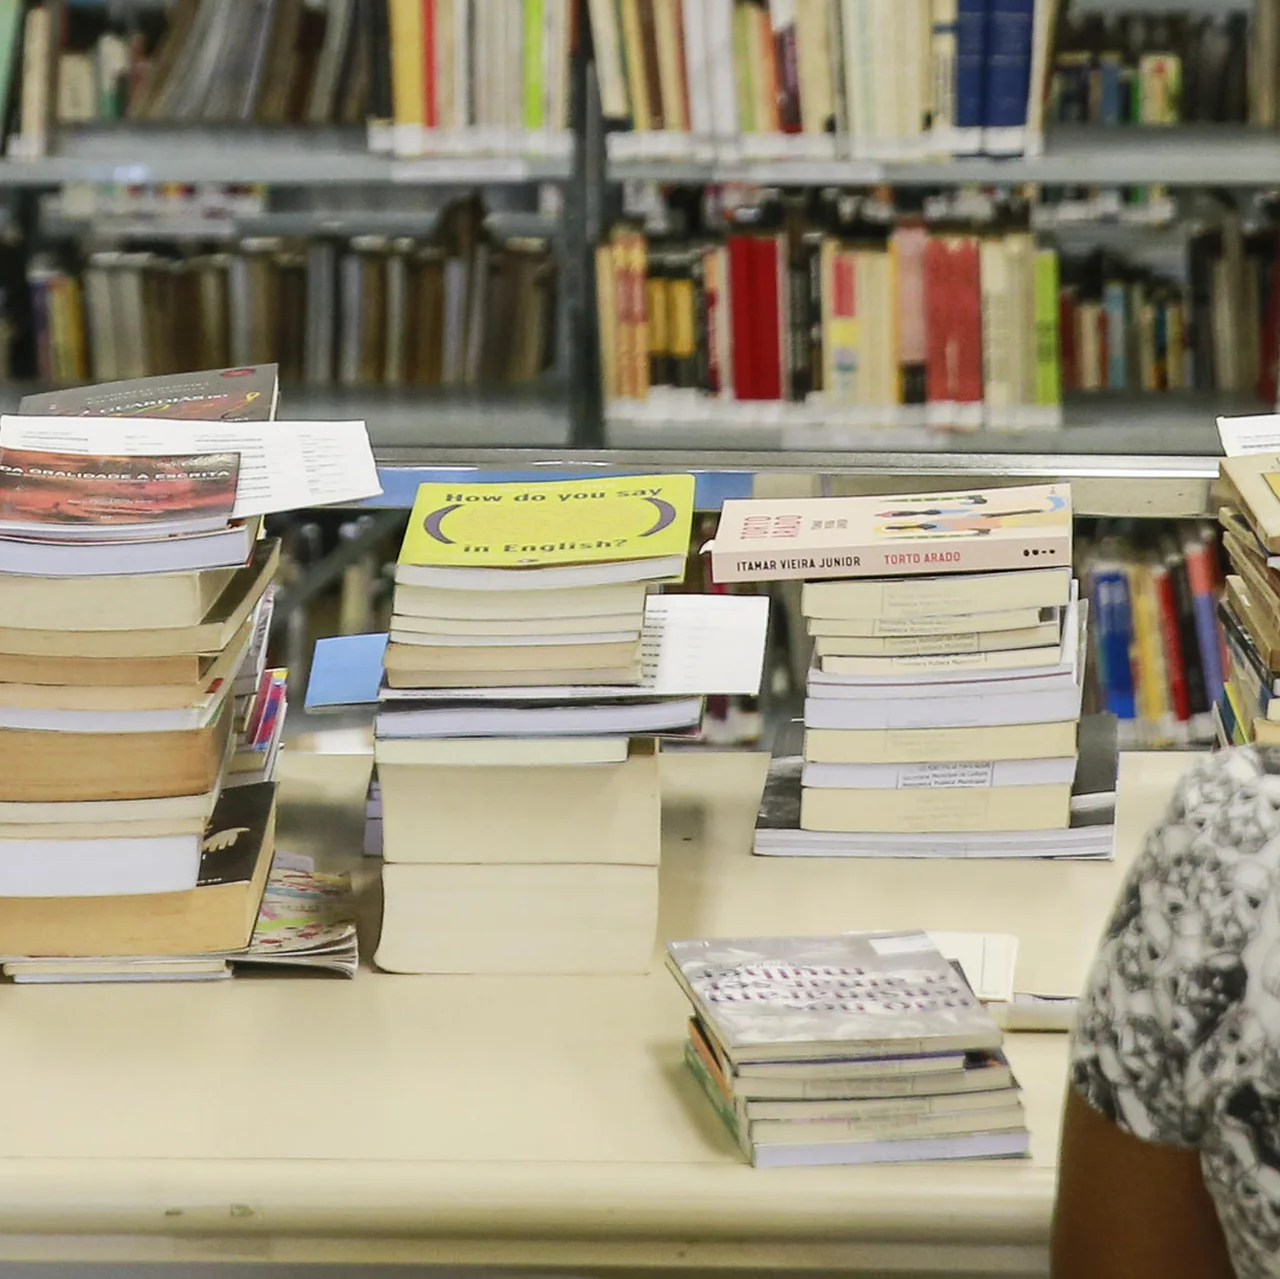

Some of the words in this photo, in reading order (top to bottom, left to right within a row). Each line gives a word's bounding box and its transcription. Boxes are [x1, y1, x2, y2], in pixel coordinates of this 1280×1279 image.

[28, 467, 132, 480] ORALIDADE
[154, 469, 231, 481] ESCRITA
[445, 492, 504, 503] How
[514, 492, 546, 502] do
[558, 491, 606, 503] you
[616, 486, 664, 499] say
[462, 544, 490, 554] in
[503, 538, 629, 554] English?
[736, 559, 777, 572] ITAMAR
[780, 558, 816, 570] VIEIRA
[819, 556, 861, 569] JUNIOR
[883, 553, 921, 565] TORTO
[923, 551, 961, 564] ARADO
